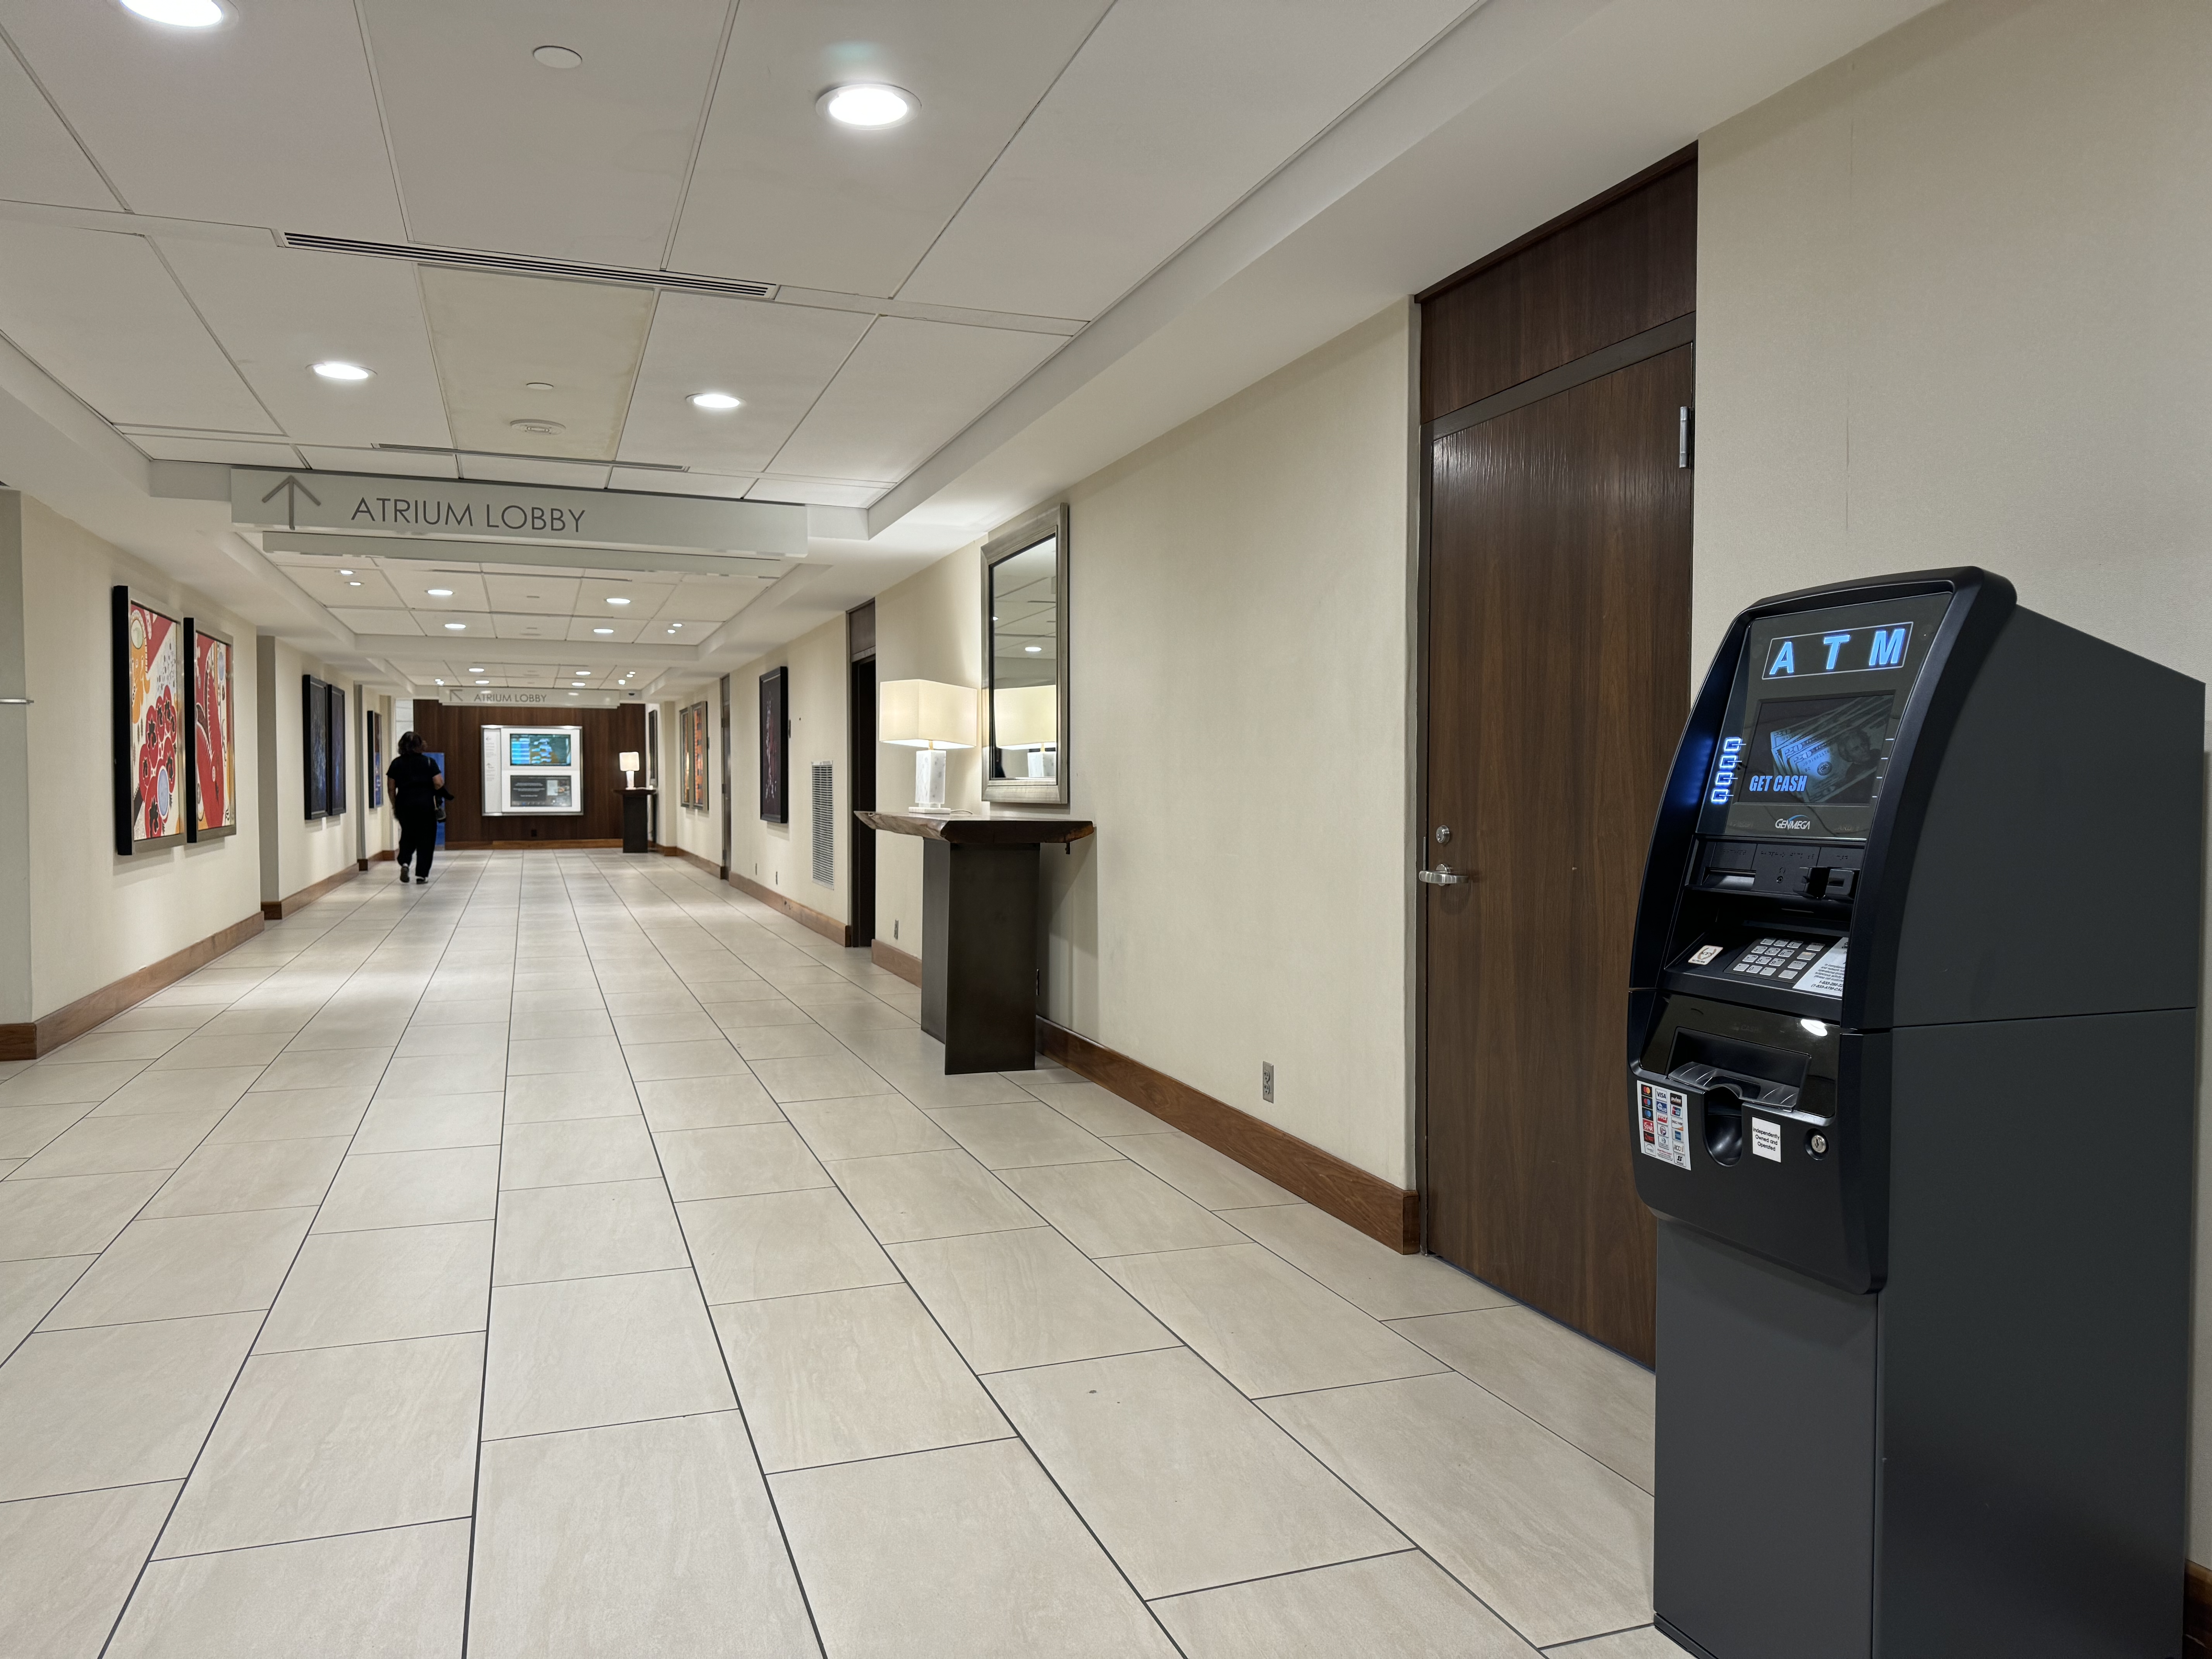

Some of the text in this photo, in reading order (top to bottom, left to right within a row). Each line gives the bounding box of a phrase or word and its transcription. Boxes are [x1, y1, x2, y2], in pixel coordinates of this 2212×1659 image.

[351, 497, 586, 533] ATRIUM LOBBY
[1769, 628, 1905, 675] ATM
[474, 694, 547, 702] ATRIUM LOBBY
[1749, 775, 1808, 792] GET CASH
[1775, 818, 1810, 830] GENMEGA
[1753, 1127, 1779, 1140] Independently
[1755, 1134, 1769, 1143] Owned
[1757, 1141, 1776, 1151] Operated
